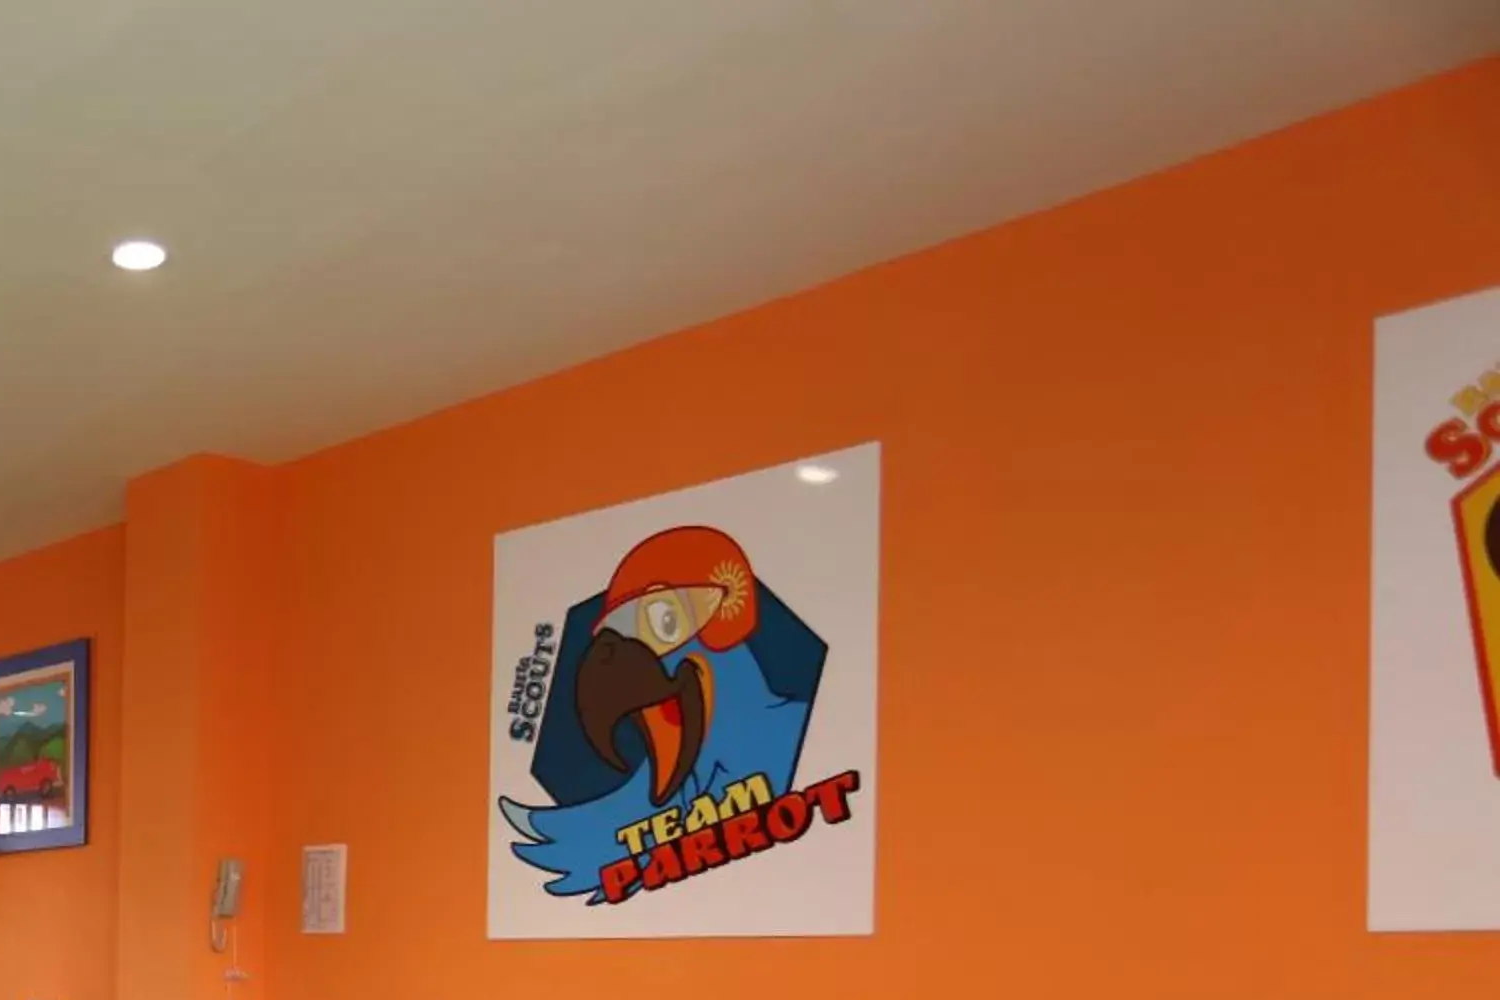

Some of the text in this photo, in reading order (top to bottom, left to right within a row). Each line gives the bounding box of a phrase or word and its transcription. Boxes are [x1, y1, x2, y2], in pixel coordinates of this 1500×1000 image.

[508, 623, 553, 743] SCOUTS
[599, 770, 861, 904] PARROT
[616, 773, 774, 856] TEAM
